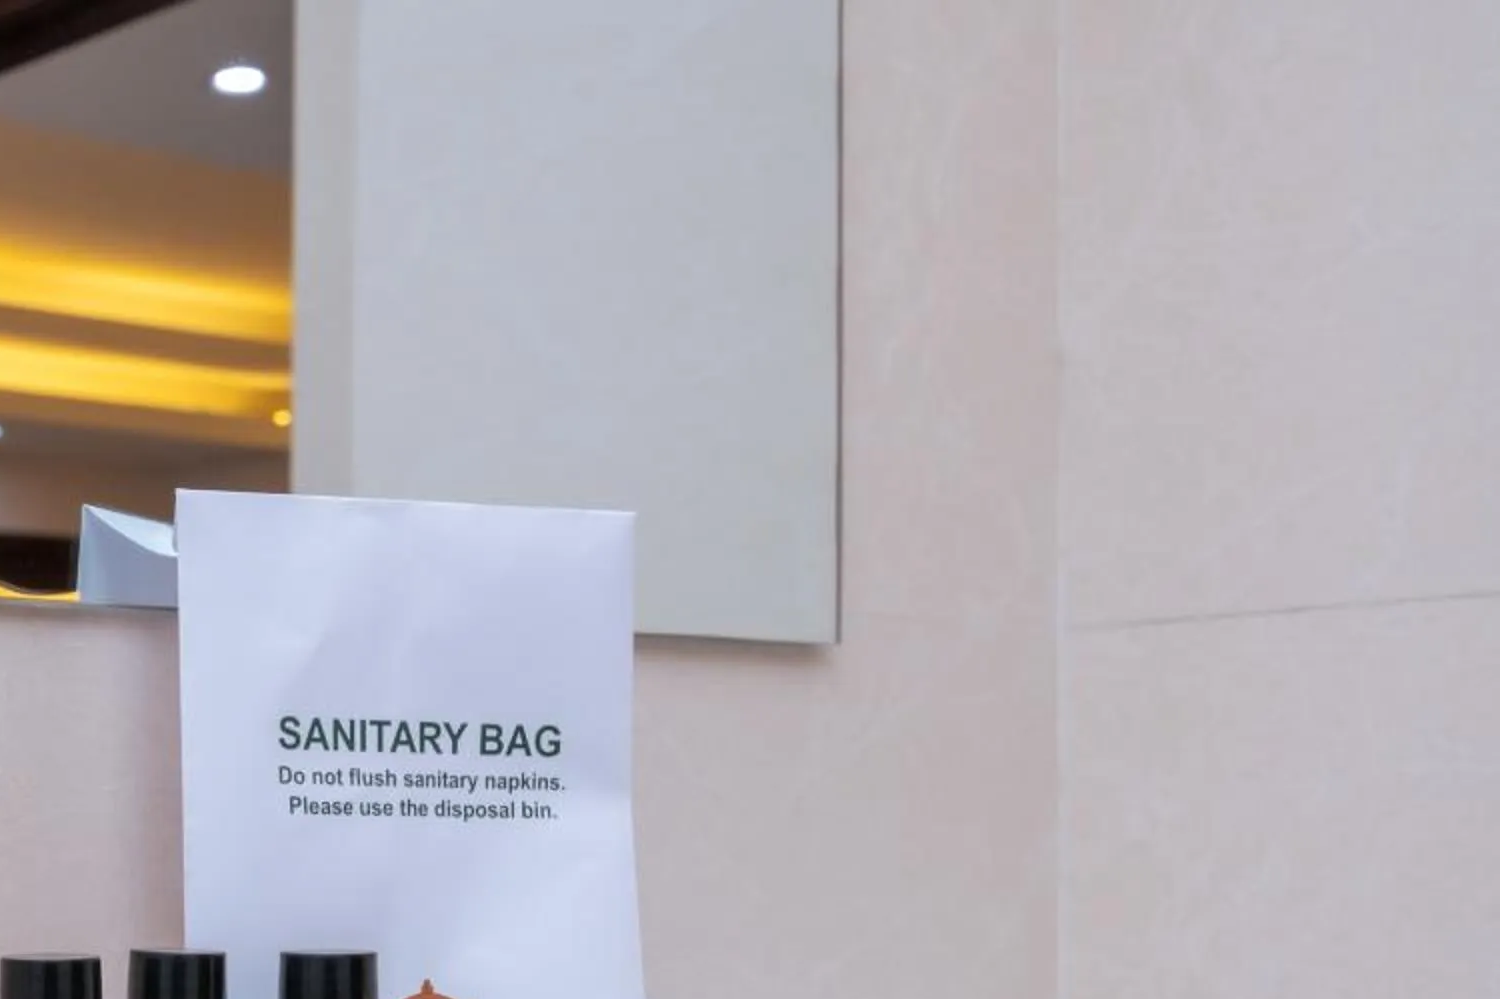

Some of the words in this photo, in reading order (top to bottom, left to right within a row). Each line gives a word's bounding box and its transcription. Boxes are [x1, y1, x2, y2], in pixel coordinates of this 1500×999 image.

[278, 715, 468, 754] SANITARY
[479, 723, 562, 757] BAG
[278, 765, 305, 785] Do
[312, 768, 343, 786] not
[349, 768, 397, 788] flush
[403, 770, 478, 794] sanitary
[484, 773, 566, 795] napkins.
[289, 796, 353, 815] Please
[360, 801, 394, 817] use
[399, 799, 429, 817] the
[435, 800, 515, 822] disposal
[521, 804, 558, 820] bin.
